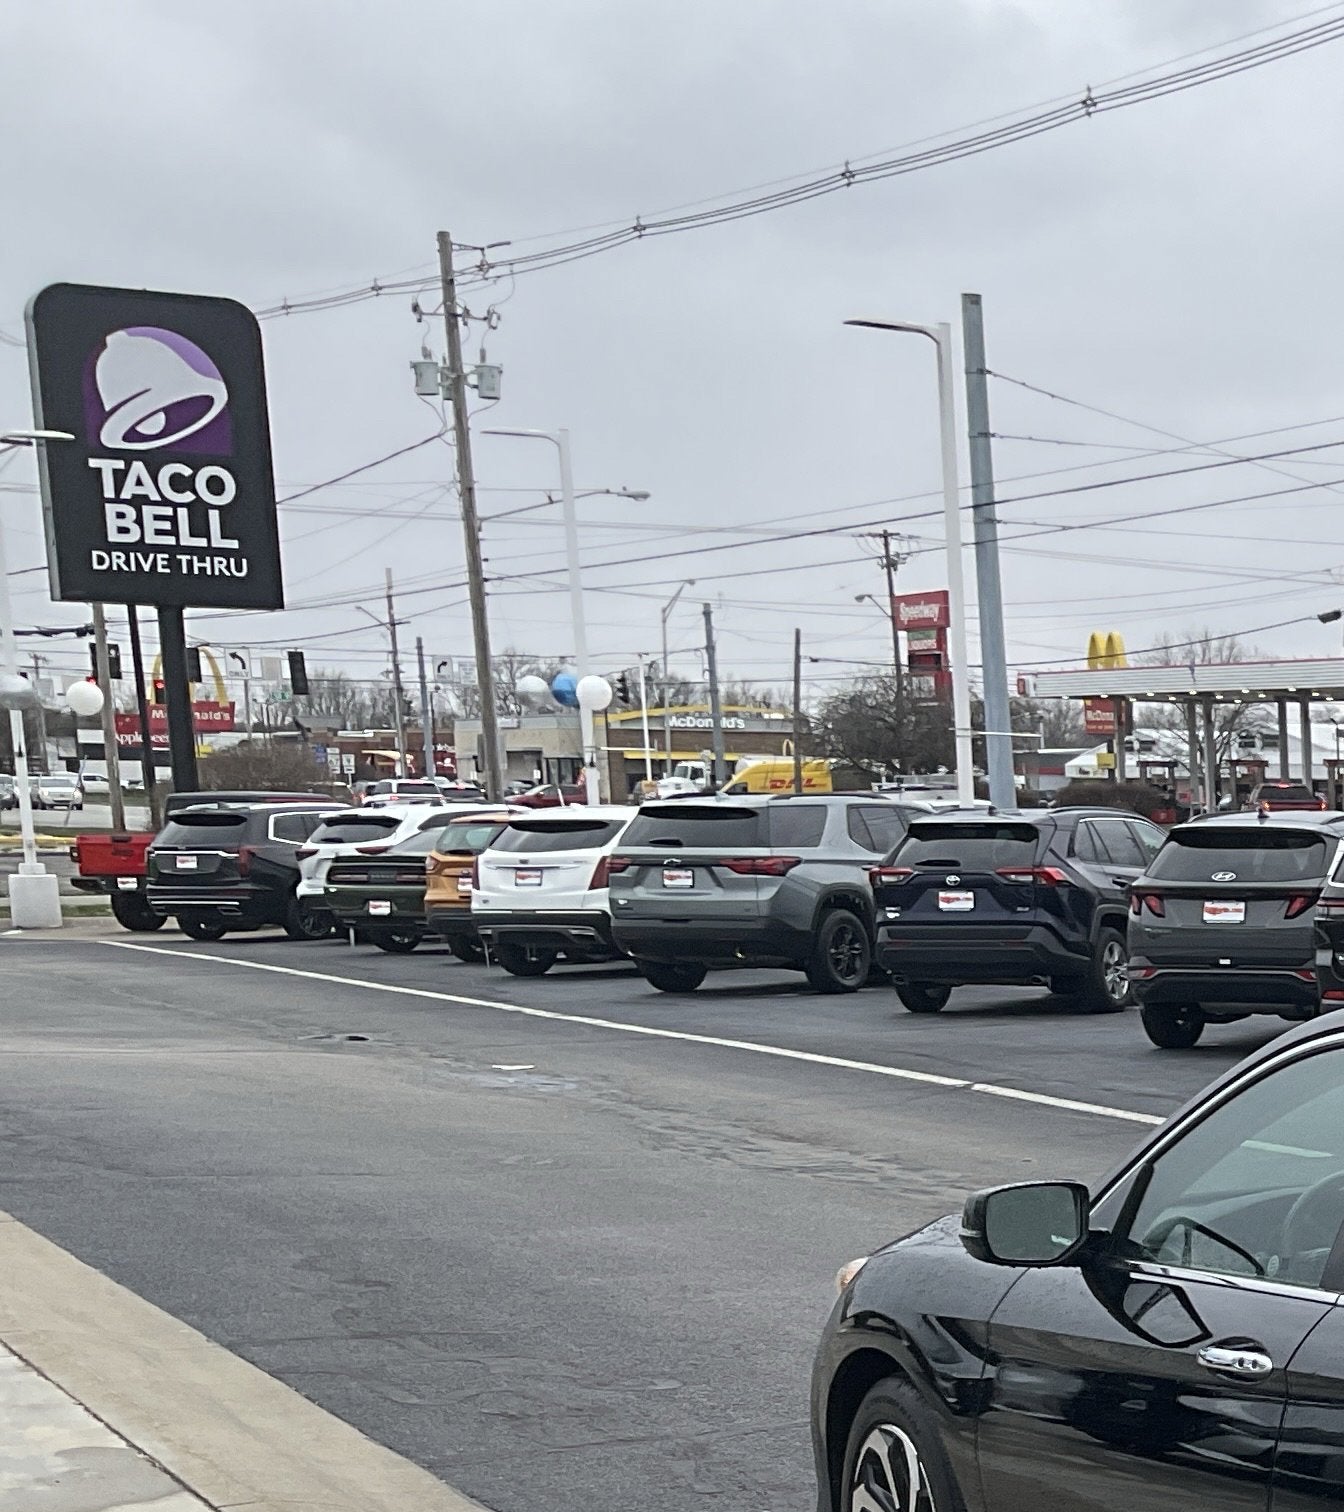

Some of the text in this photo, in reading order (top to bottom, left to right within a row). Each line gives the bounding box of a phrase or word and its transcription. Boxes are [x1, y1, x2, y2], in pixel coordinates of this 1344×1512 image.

[88, 457, 237, 506] TACO
[104, 502, 240, 549] BELL
[91, 550, 248, 577] DRIVE THRU
